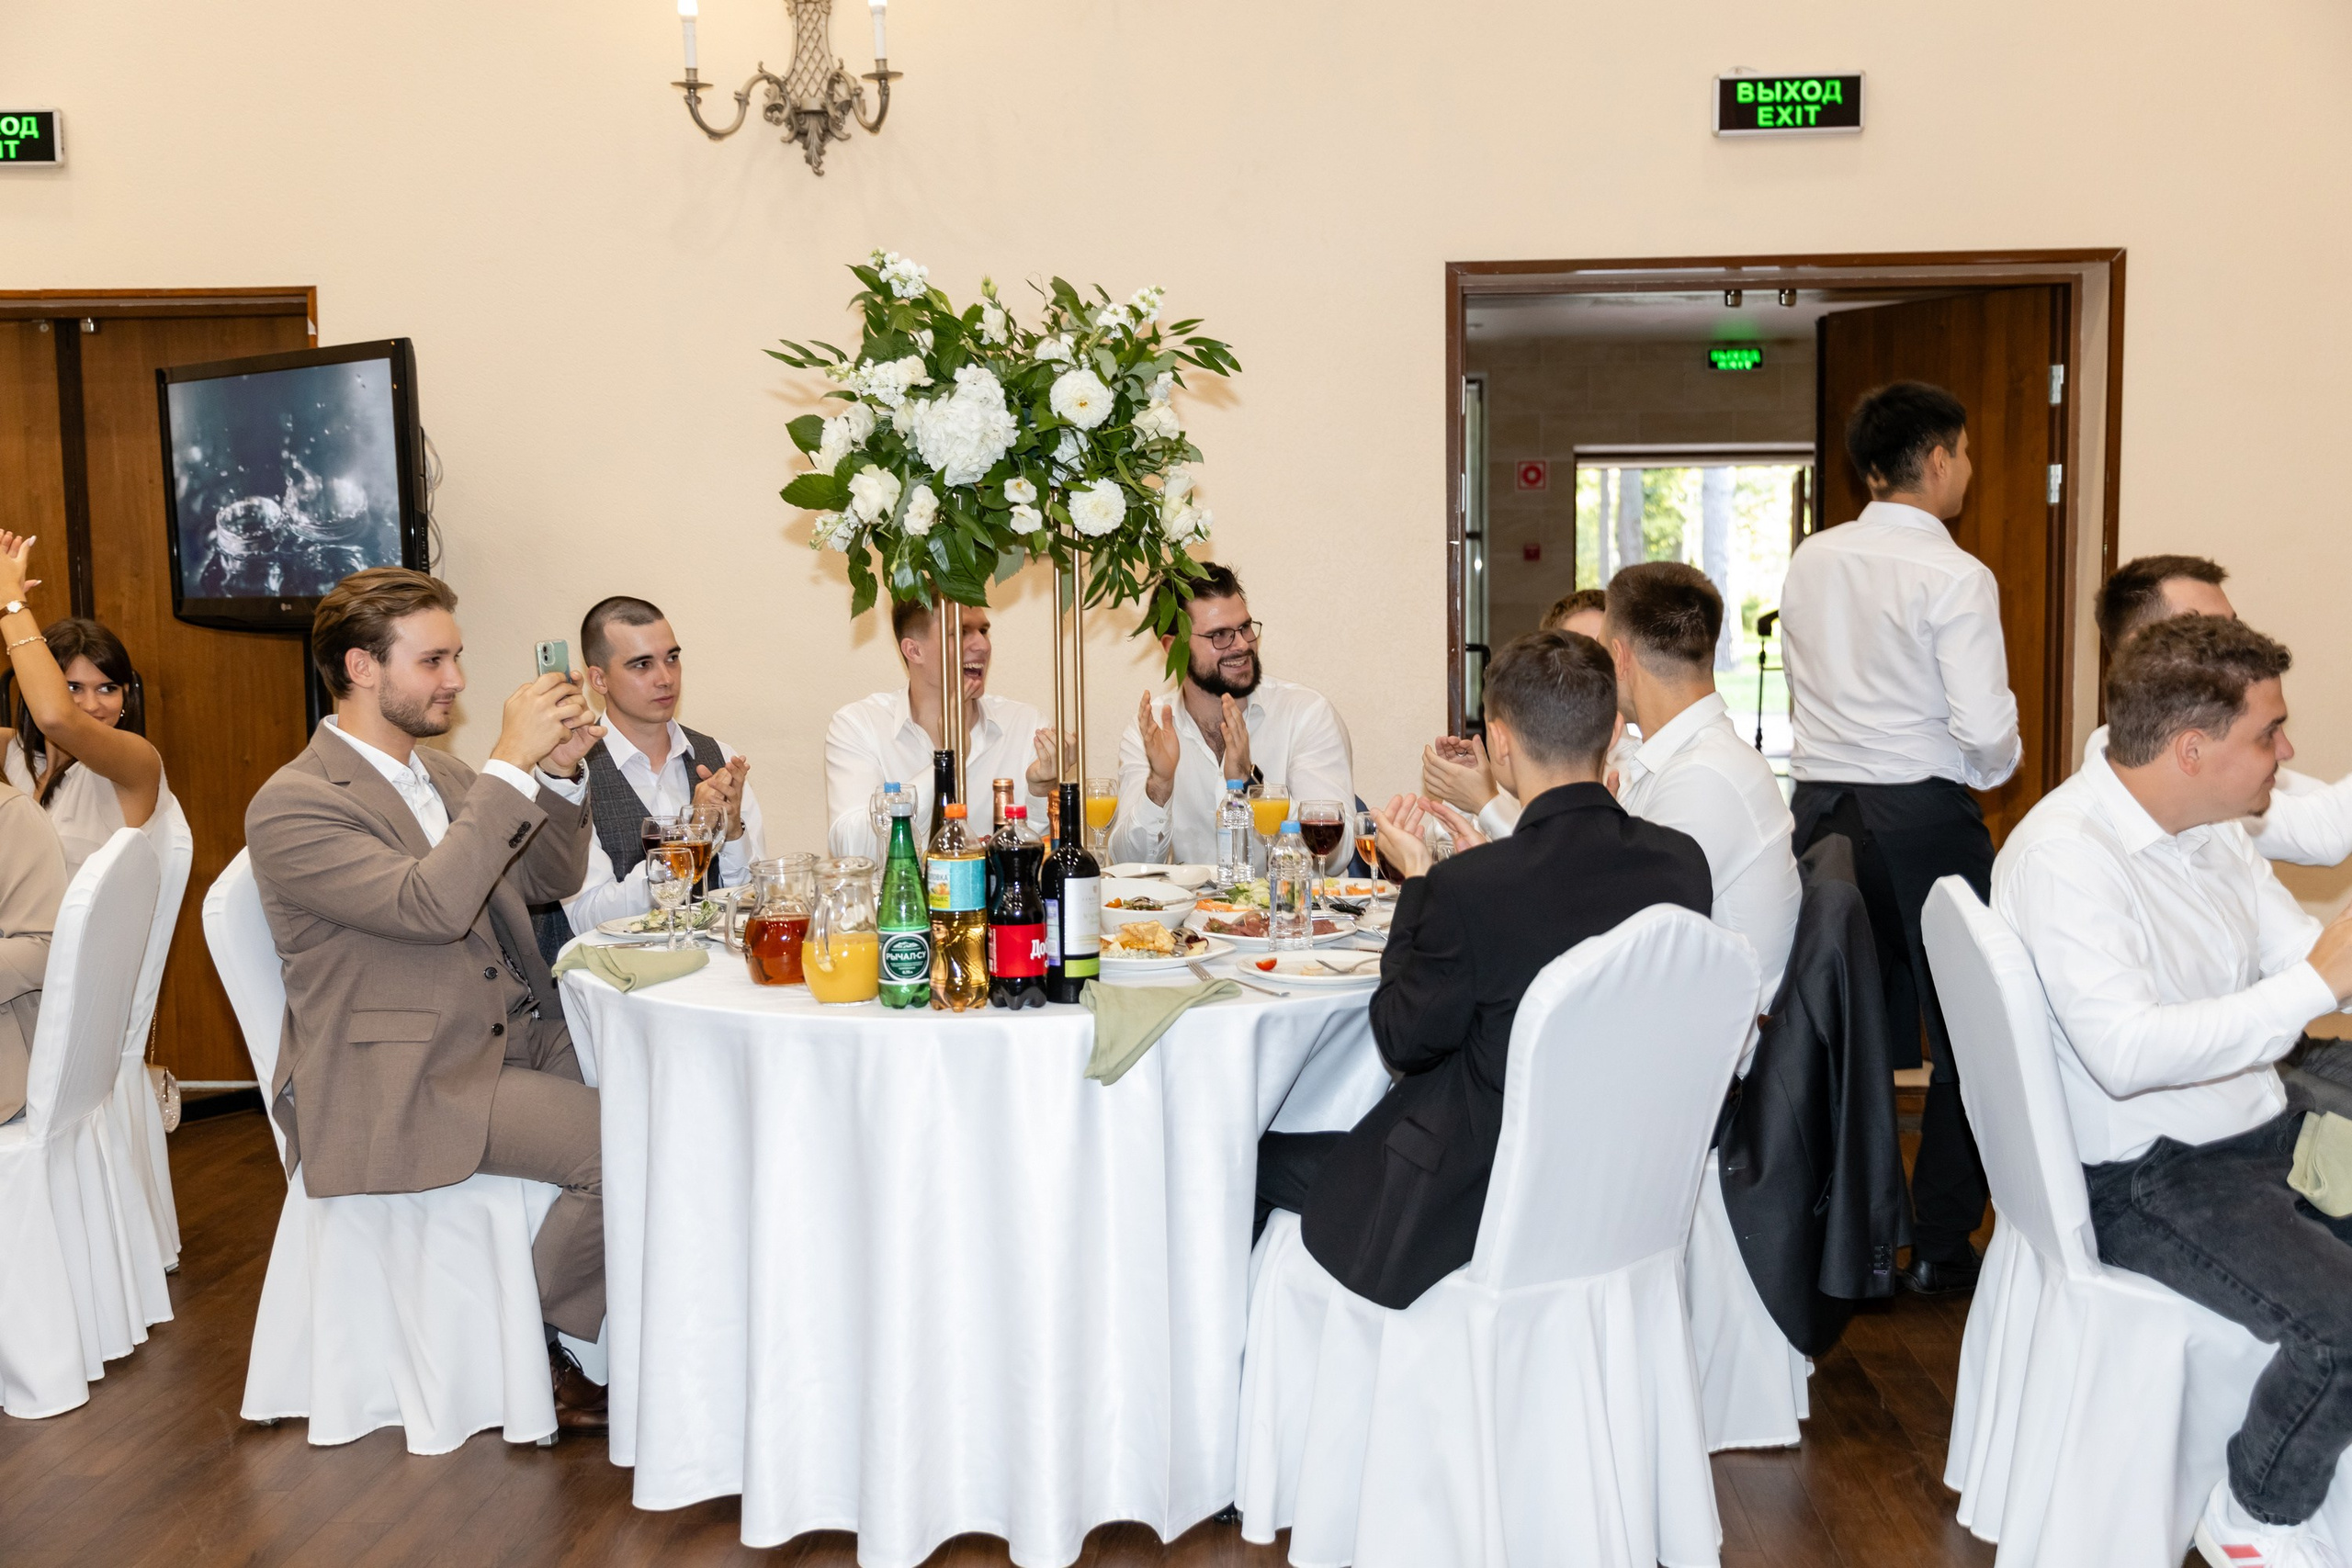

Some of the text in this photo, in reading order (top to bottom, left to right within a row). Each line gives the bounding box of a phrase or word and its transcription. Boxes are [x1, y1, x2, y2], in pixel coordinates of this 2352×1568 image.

[1736, 79, 1843, 105] ВЫХОД
[0, 116, 40, 139] ОД
[1757, 104, 1822, 128] EXIT
